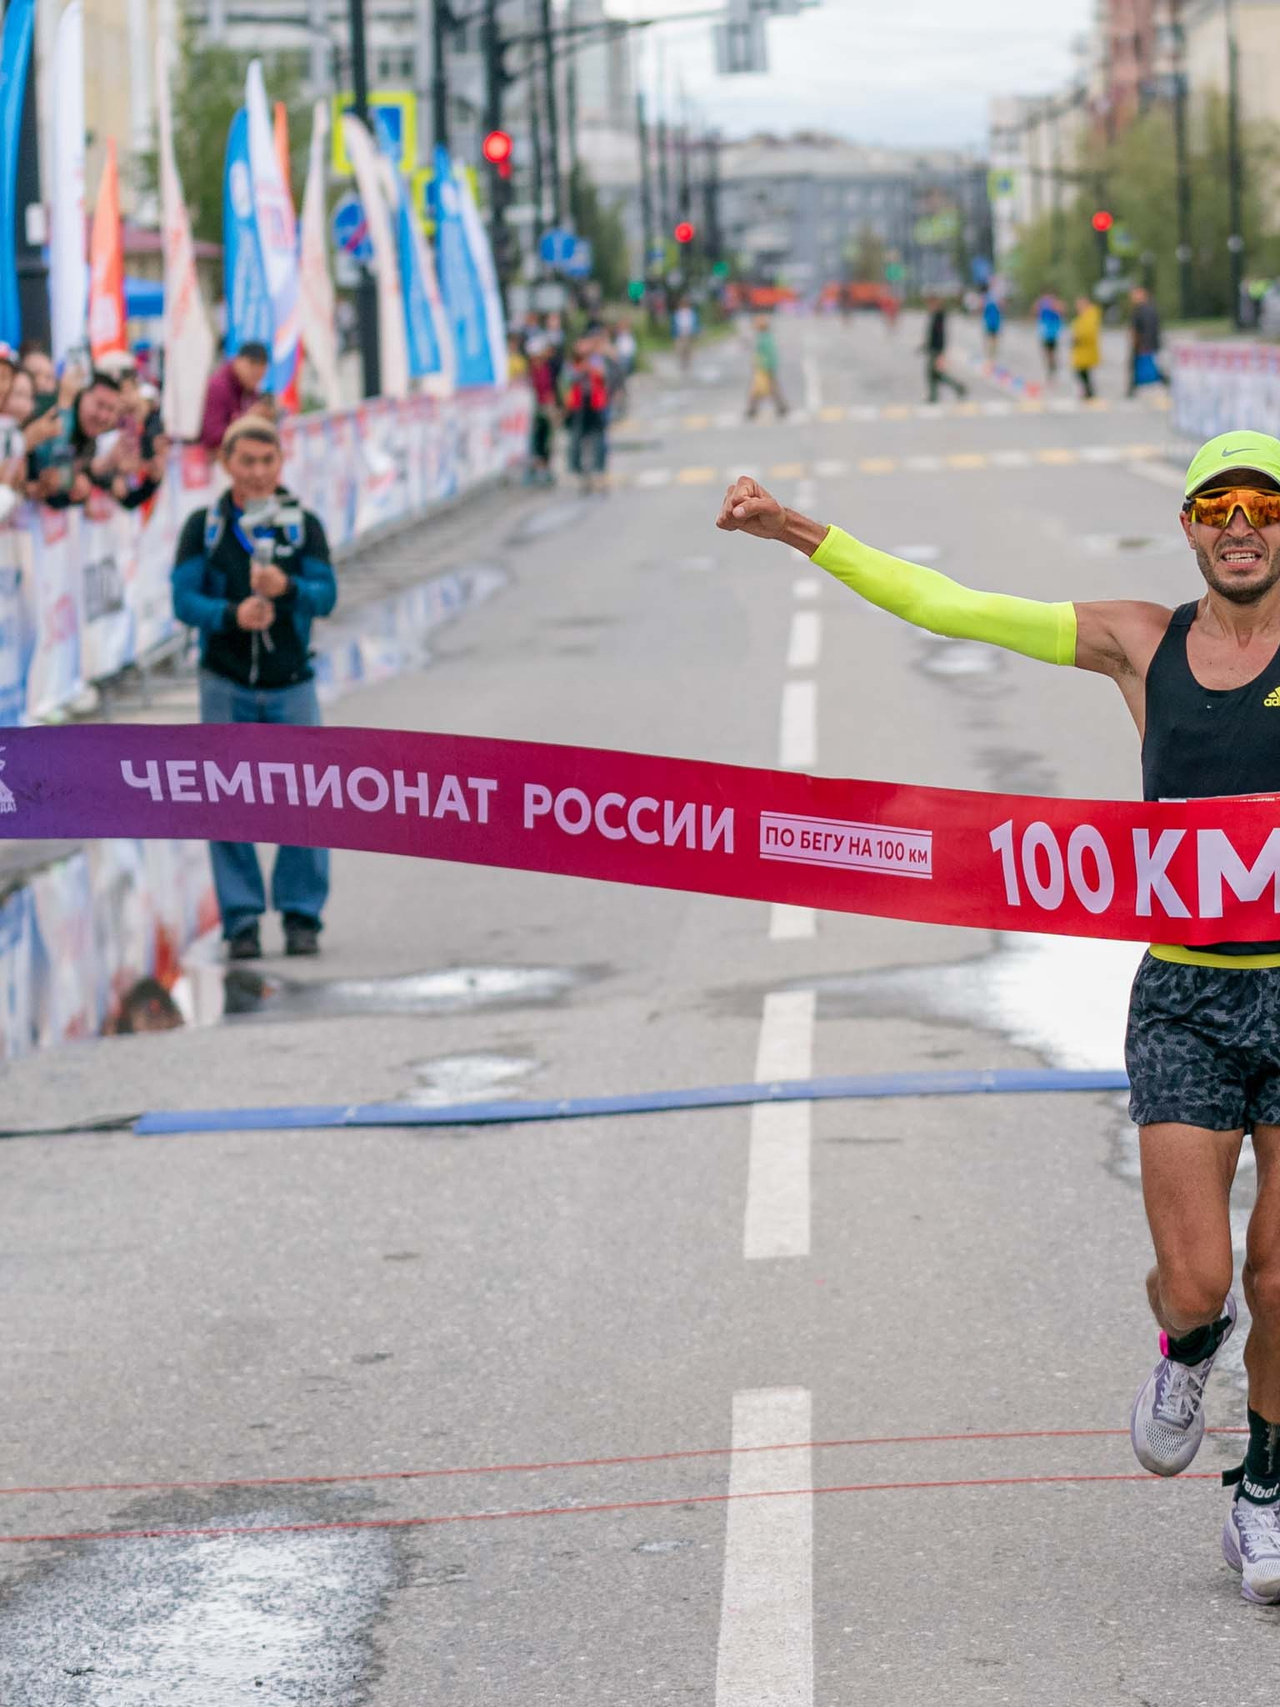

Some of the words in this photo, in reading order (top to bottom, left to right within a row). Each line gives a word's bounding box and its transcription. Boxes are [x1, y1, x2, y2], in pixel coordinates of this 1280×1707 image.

[120, 759, 498, 824] ЧЕМПИОНАТ
[523, 782, 735, 854] РОССИИ
[765, 826, 795, 847] ПО
[800, 830, 845, 853] БЕГУ
[849, 836, 872, 857] НА
[876, 839, 905, 861] 100
[988, 819, 1116, 914] 100
